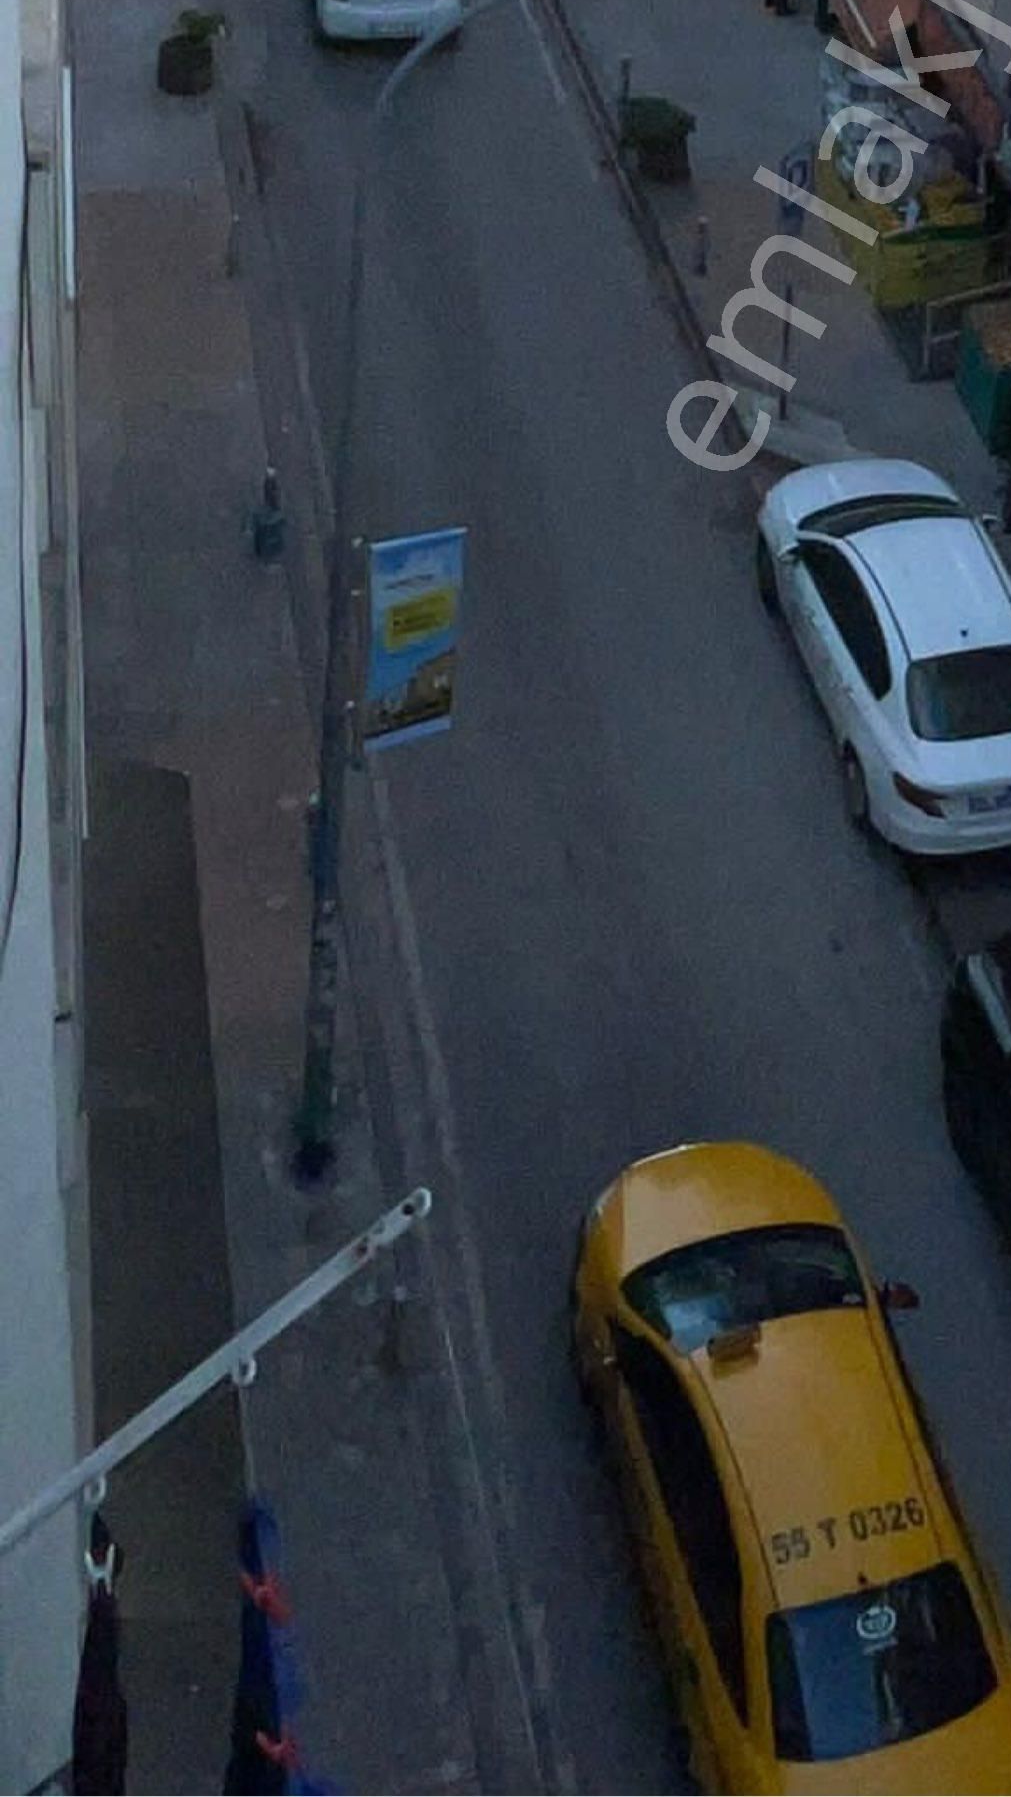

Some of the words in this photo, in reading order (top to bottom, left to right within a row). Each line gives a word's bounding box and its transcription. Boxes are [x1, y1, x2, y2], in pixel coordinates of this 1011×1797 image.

[772, 1526, 810, 1564] 55
[818, 1517, 837, 1549] T
[849, 1497, 924, 1541] 0326
